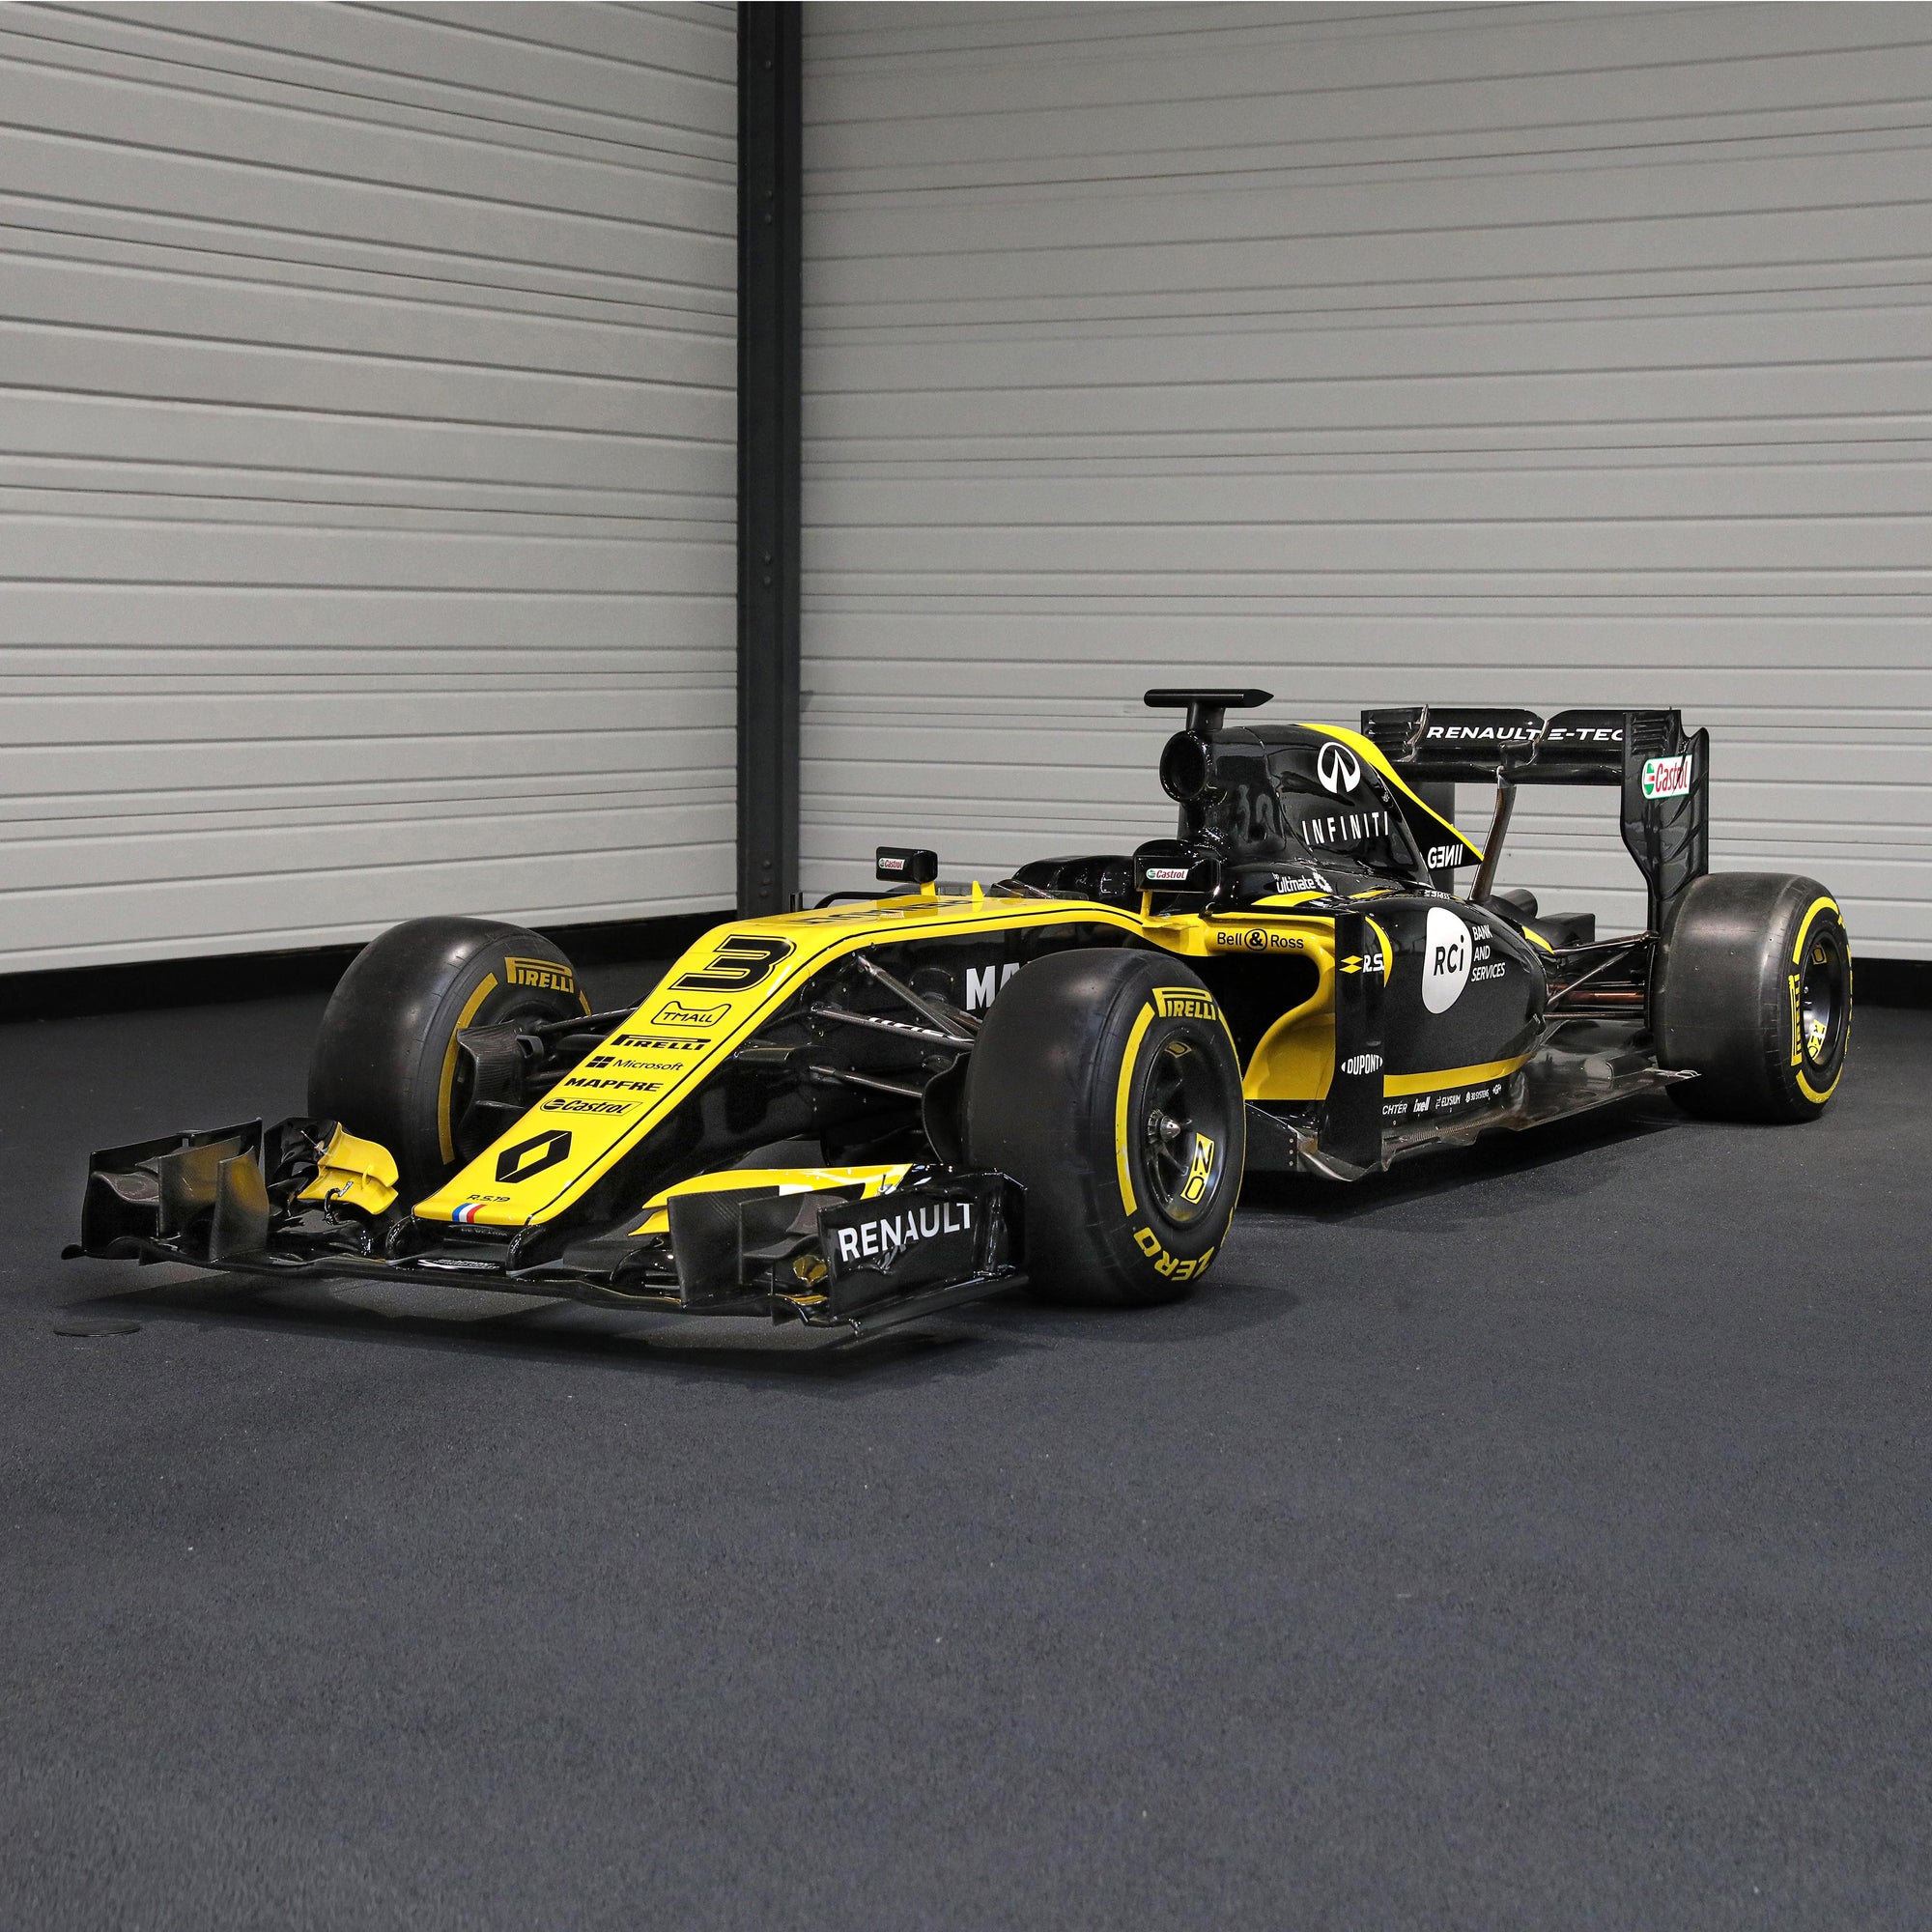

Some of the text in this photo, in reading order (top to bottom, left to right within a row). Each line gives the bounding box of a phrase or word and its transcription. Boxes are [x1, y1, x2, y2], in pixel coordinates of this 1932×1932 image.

[1426, 725, 1542, 740] RENAULT
[1655, 760, 1689, 793] Castrol
[1301, 810, 1389, 846] INFINITI
[1155, 869, 1186, 880] Castrol
[1276, 874, 1317, 895] ultimate
[1217, 931, 1242, 947] Bell
[1270, 934, 1304, 950] Ross
[1471, 923, 1493, 942] BANK
[1473, 945, 1491, 962] AND
[668, 934, 798, 993] 3
[1470, 962, 1506, 982] SERVICES
[504, 956, 574, 994] PIRELLI
[1151, 986, 1217, 1021] PIRELLI
[663, 1011, 713, 1023] TMALL
[610, 1034, 712, 1051] PIRELLI
[612, 1059, 684, 1071] Microsoft
[1347, 1054, 1380, 1075] DUPONT
[564, 1077, 664, 1093] MAPFRE
[560, 1099, 633, 1114] Castrol
[838, 1202, 975, 1263] RENAULT
[1133, 1226, 1215, 1282] ZERO
